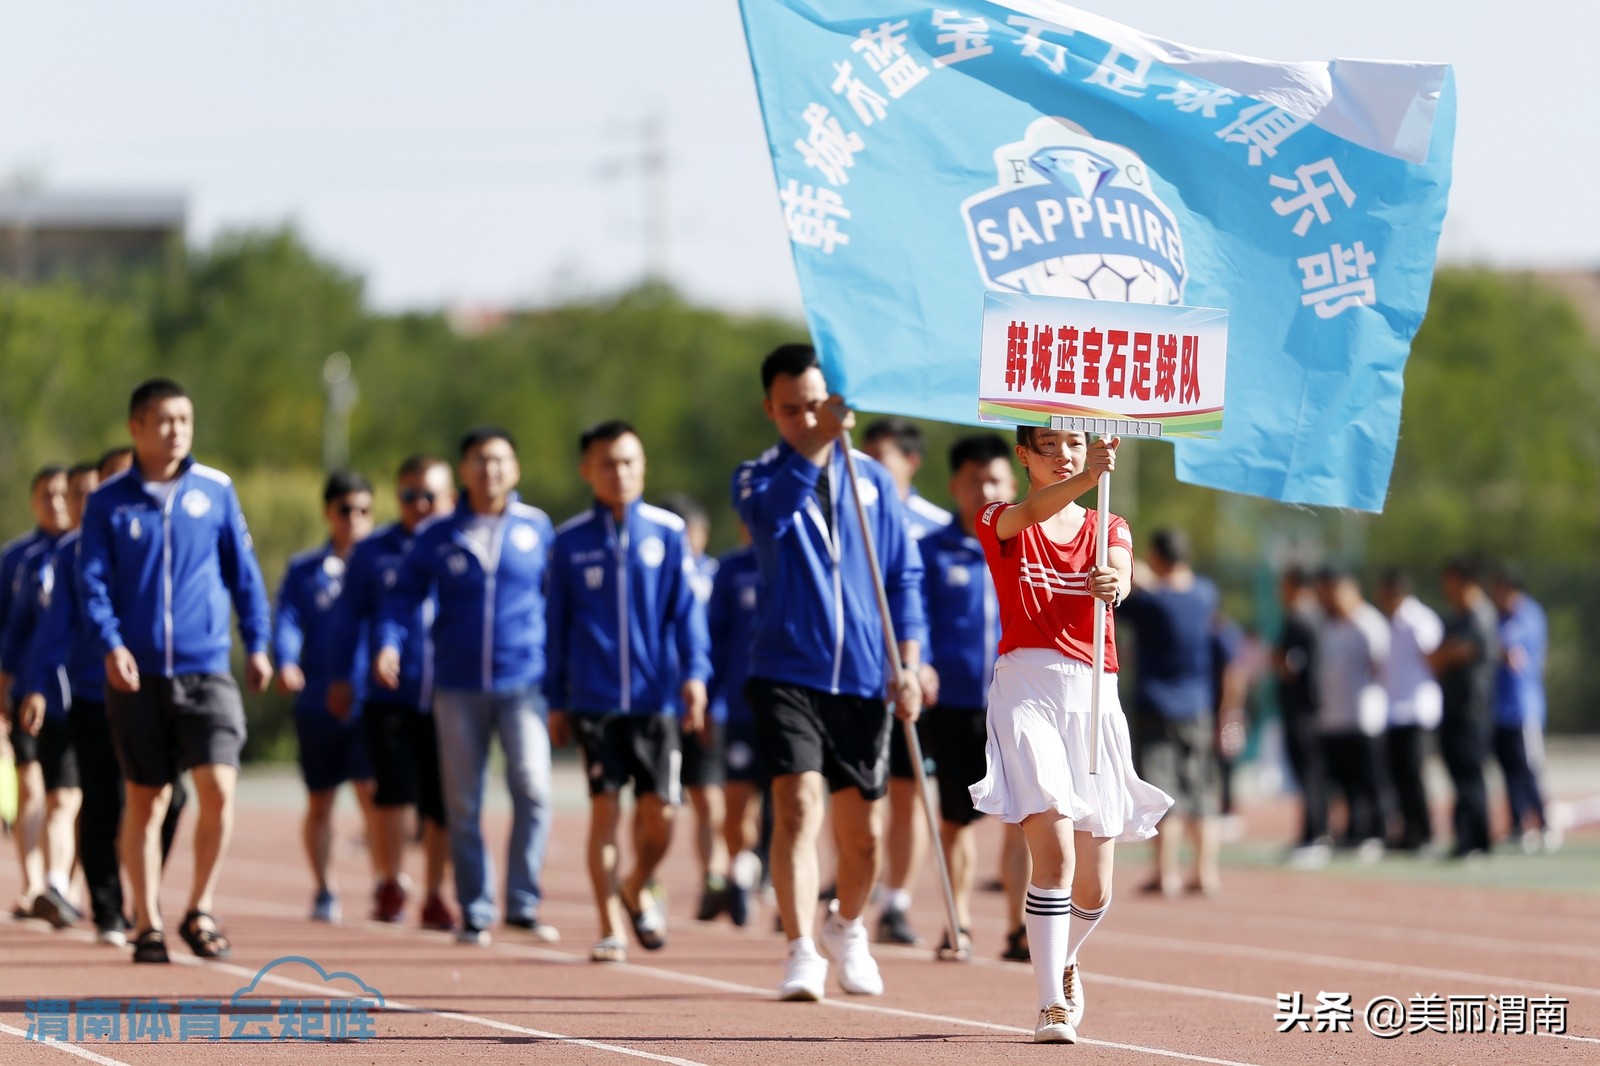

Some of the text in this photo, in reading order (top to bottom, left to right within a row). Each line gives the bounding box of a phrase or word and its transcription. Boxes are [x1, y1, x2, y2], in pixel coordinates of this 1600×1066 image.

[1008, 158, 1144, 187] F C
[976, 196, 1184, 277] SAPPHIRE
[1004, 320, 1201, 405] 韩城蓝宝石足球队
